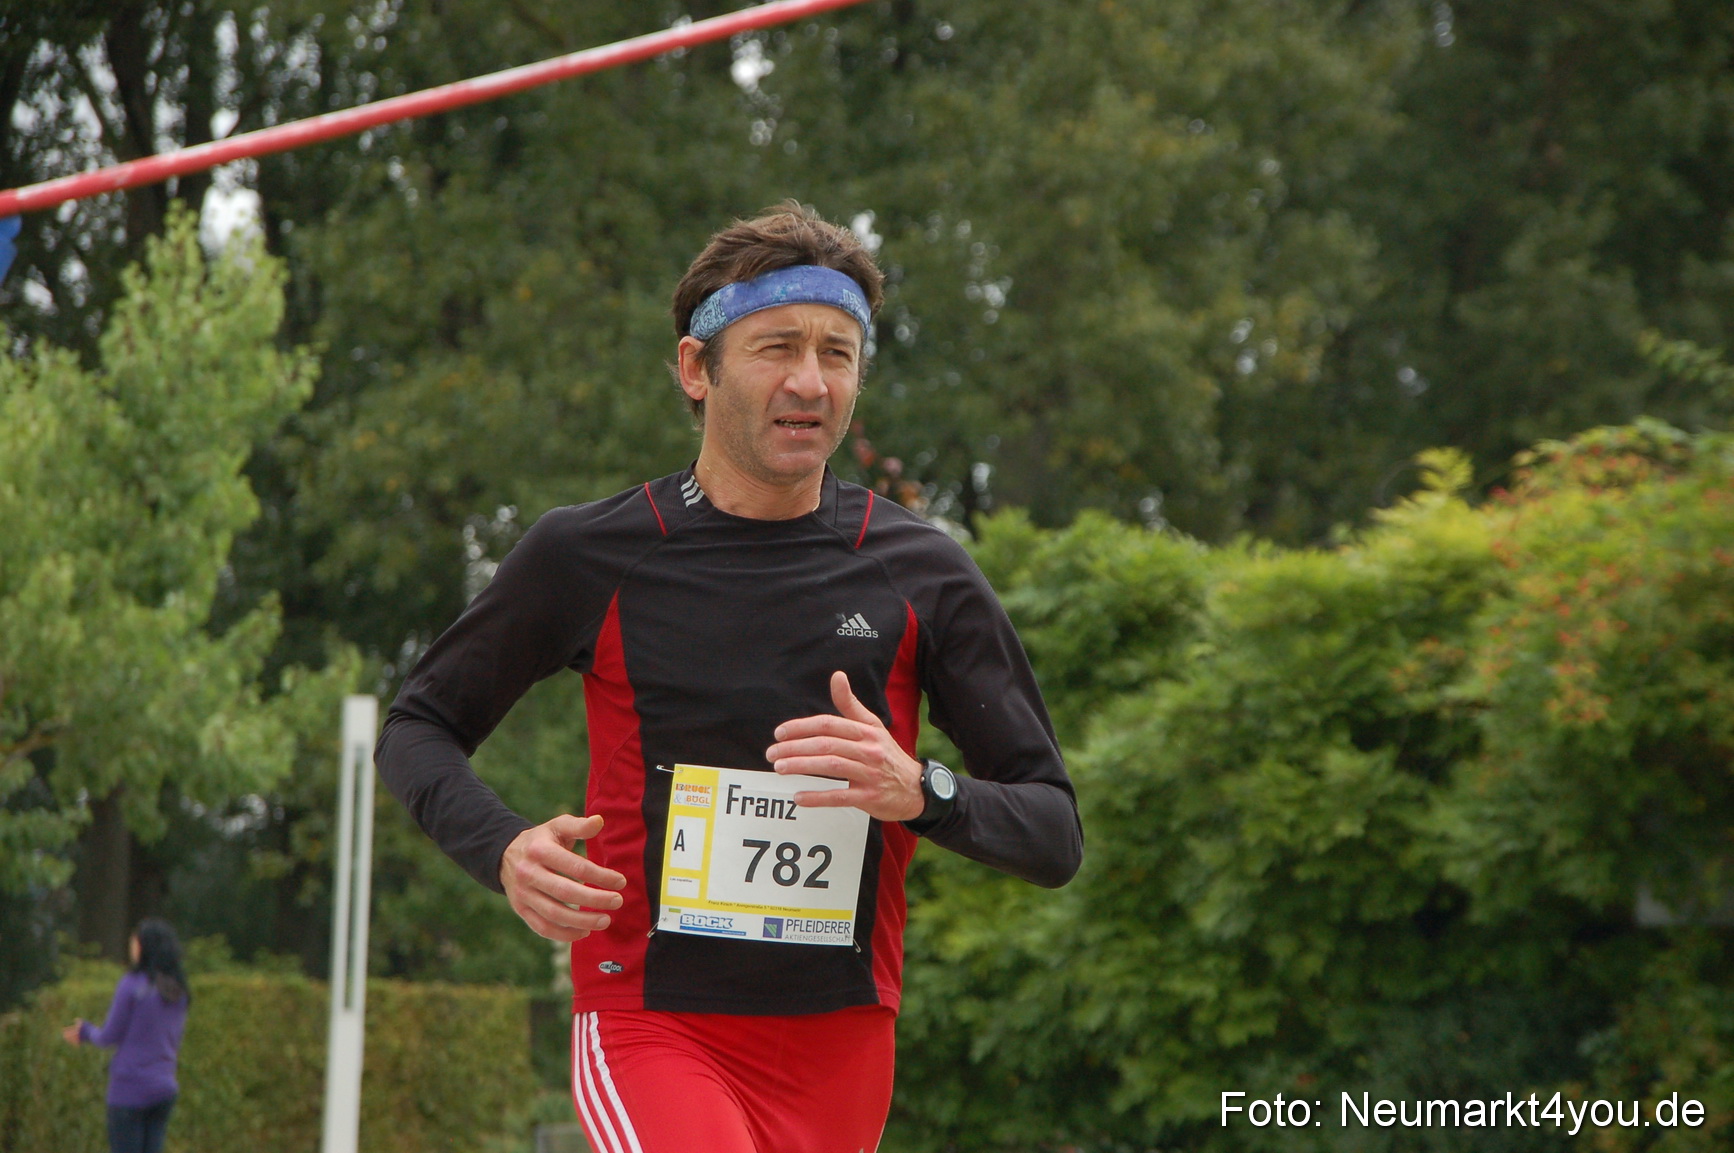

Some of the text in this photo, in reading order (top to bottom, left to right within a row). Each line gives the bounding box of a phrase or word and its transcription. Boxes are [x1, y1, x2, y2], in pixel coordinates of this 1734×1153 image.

[837, 627, 879, 638] adidas
[726, 784, 798, 820] Franz
[673, 828, 685, 852] A
[742, 838, 833, 889] 782
[680, 914, 734, 929] BOCK
[786, 919, 851, 934] PFLEIDERER
